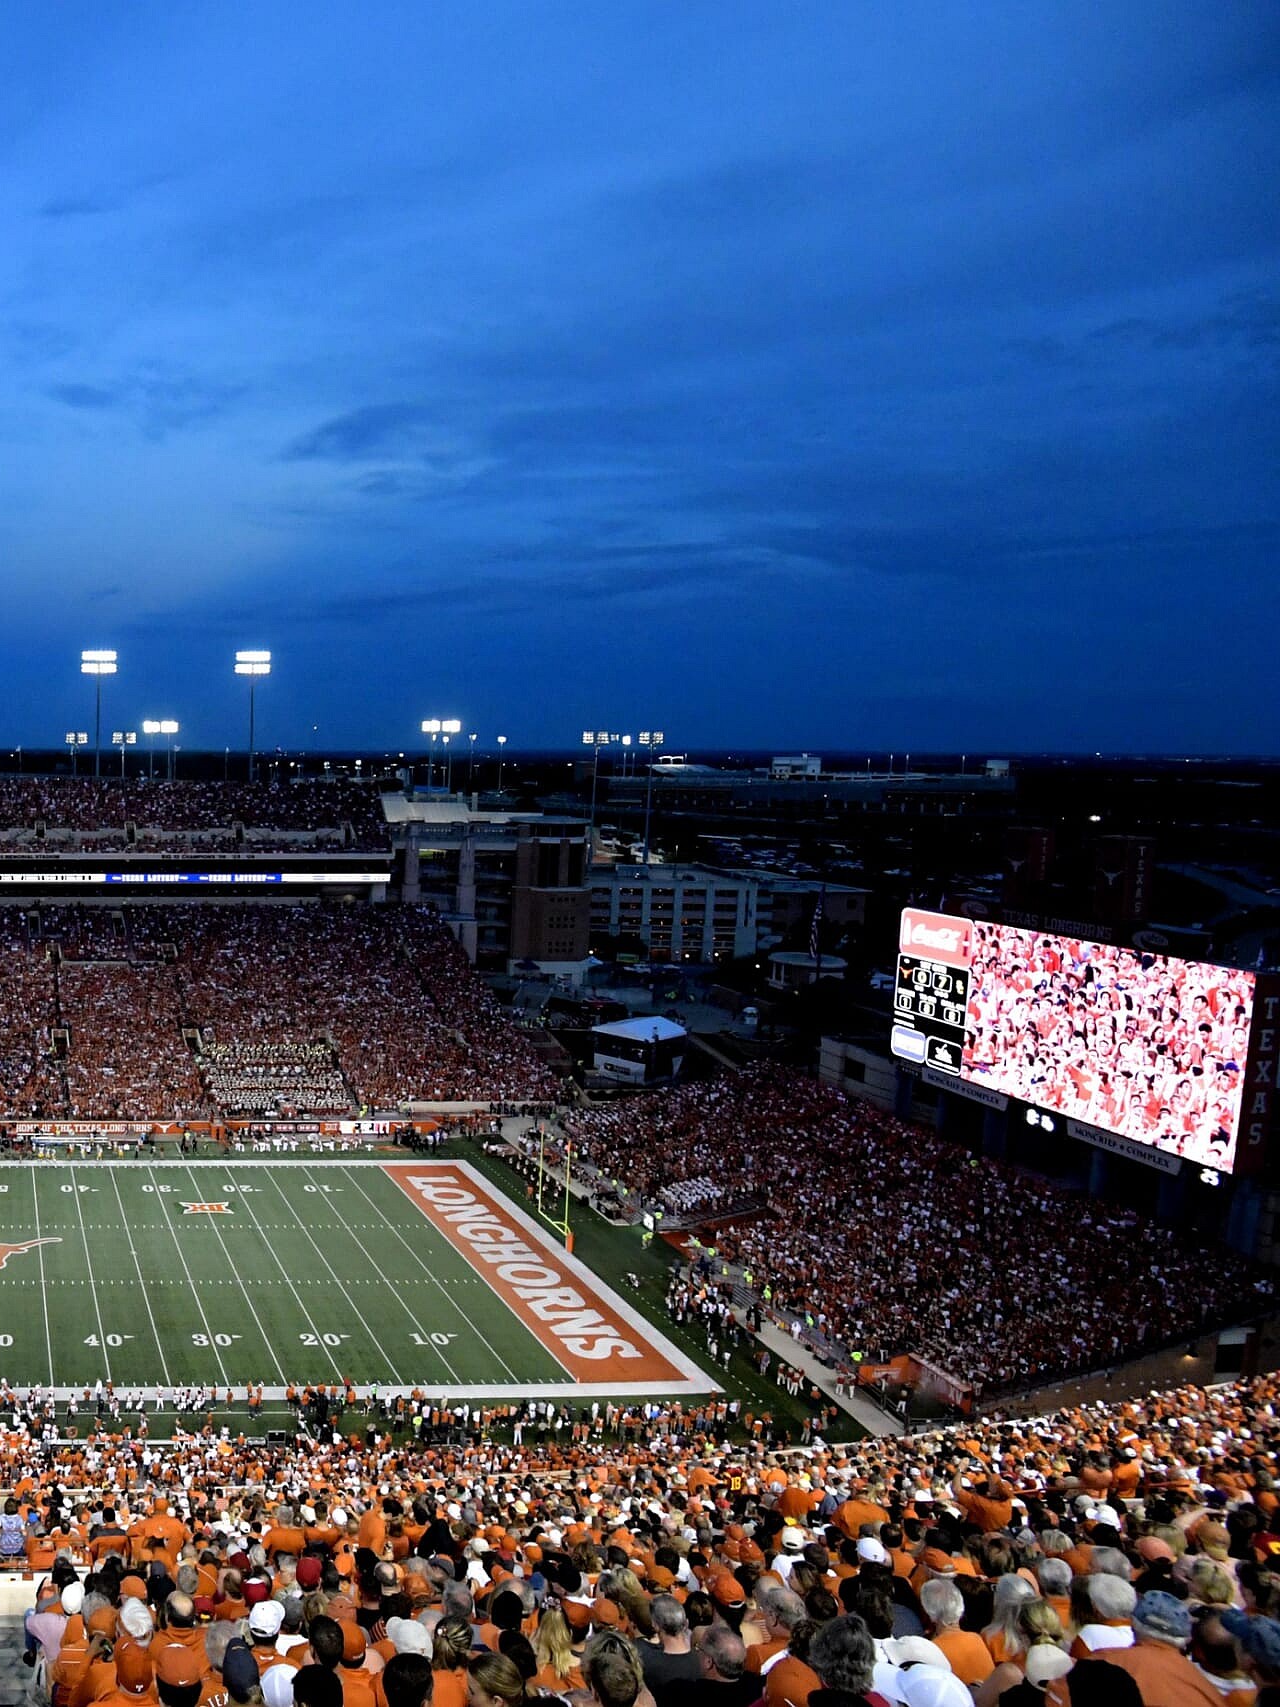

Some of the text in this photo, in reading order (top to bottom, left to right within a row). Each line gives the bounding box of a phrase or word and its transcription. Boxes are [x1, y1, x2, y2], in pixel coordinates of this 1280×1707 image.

[1001, 909, 1039, 928] TEXAS
[1044, 916, 1113, 940] LONGHORNS
[938, 976, 947, 988] 7
[1248, 997, 1279, 1145] TEXAS
[966, 1087, 999, 1105] COMPLEX
[73, 1123, 101, 1133] TEXAS
[104, 1123, 152, 1133] LONGRNS
[1075, 1127, 1170, 1168] MONCRIEF COMPLEX
[60, 1184, 91, 1194] 40
[222, 1184, 254, 1194] 20
[303, 1184, 334, 1194] 10
[405, 1174, 643, 1361] LONGHORNS
[83, 1333, 123, 1348] 40
[191, 1333, 233, 1347] 30
[299, 1333, 341, 1347] 20
[409, 1332, 450, 1347] 10
[730, 1476, 741, 1491] 18
